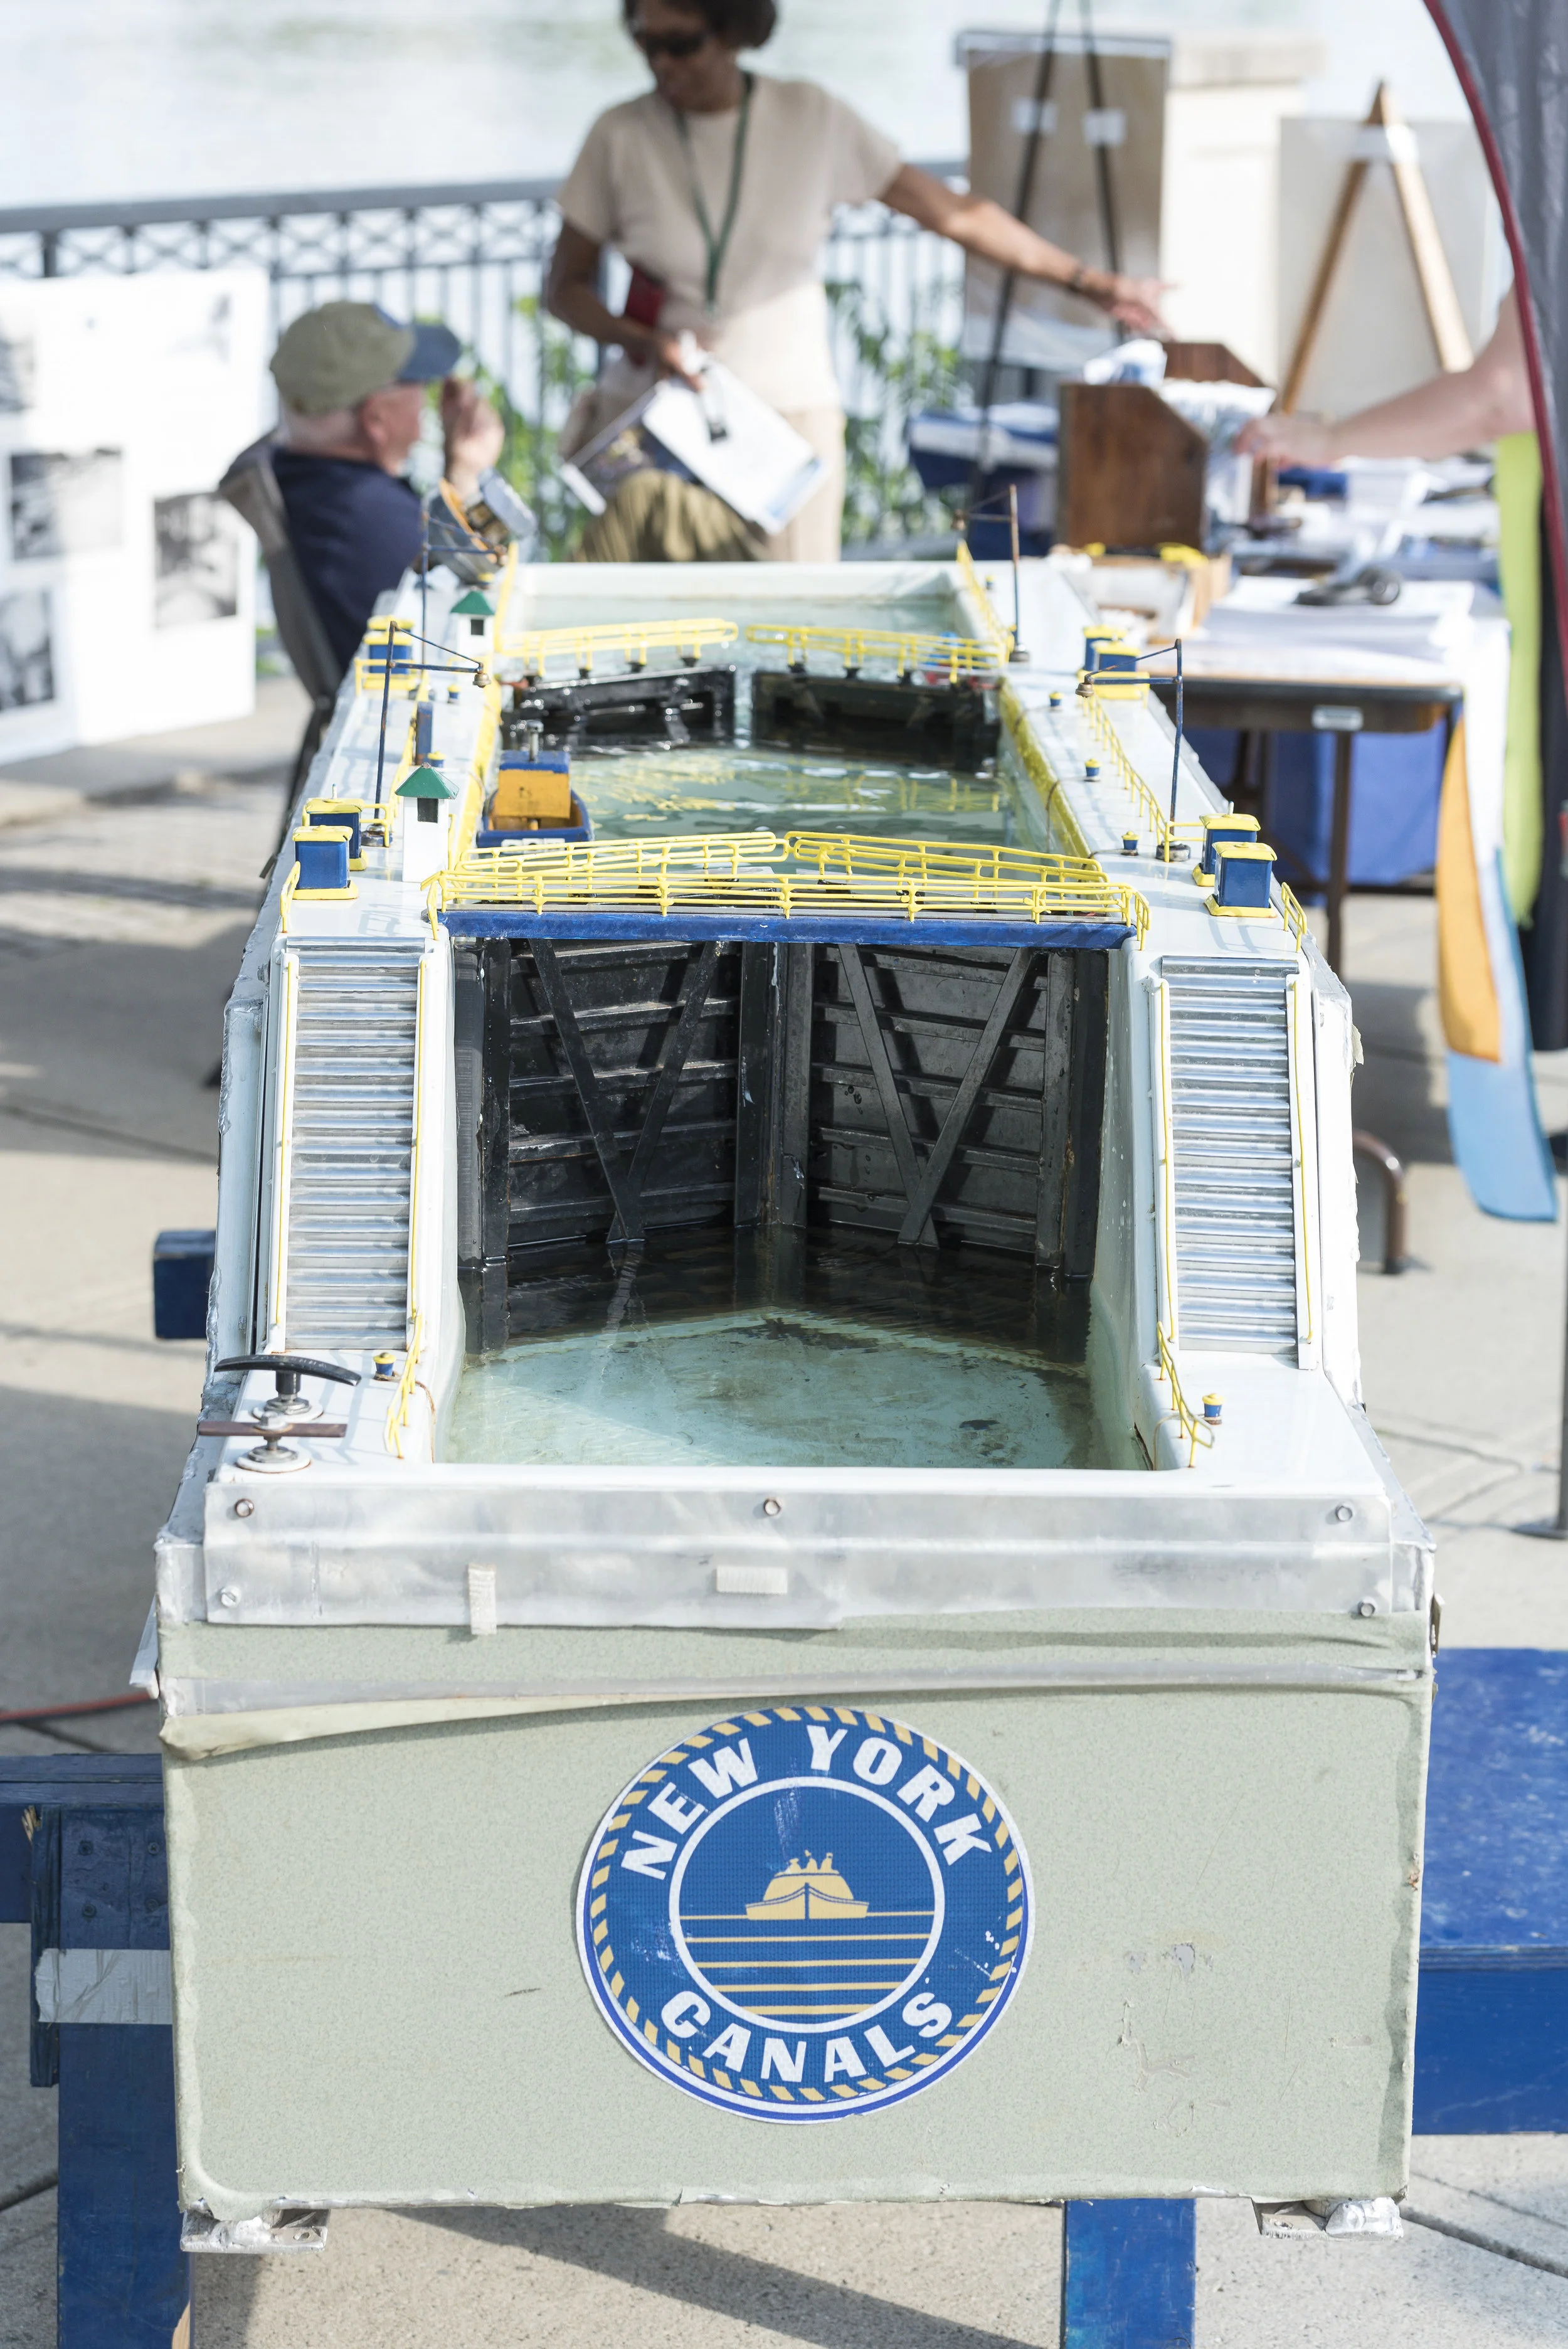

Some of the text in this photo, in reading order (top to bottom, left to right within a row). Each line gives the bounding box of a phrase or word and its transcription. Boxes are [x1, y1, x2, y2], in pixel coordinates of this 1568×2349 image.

[621, 1725, 992, 1880] NEW YORK
[661, 1991, 953, 2083] CANALS
